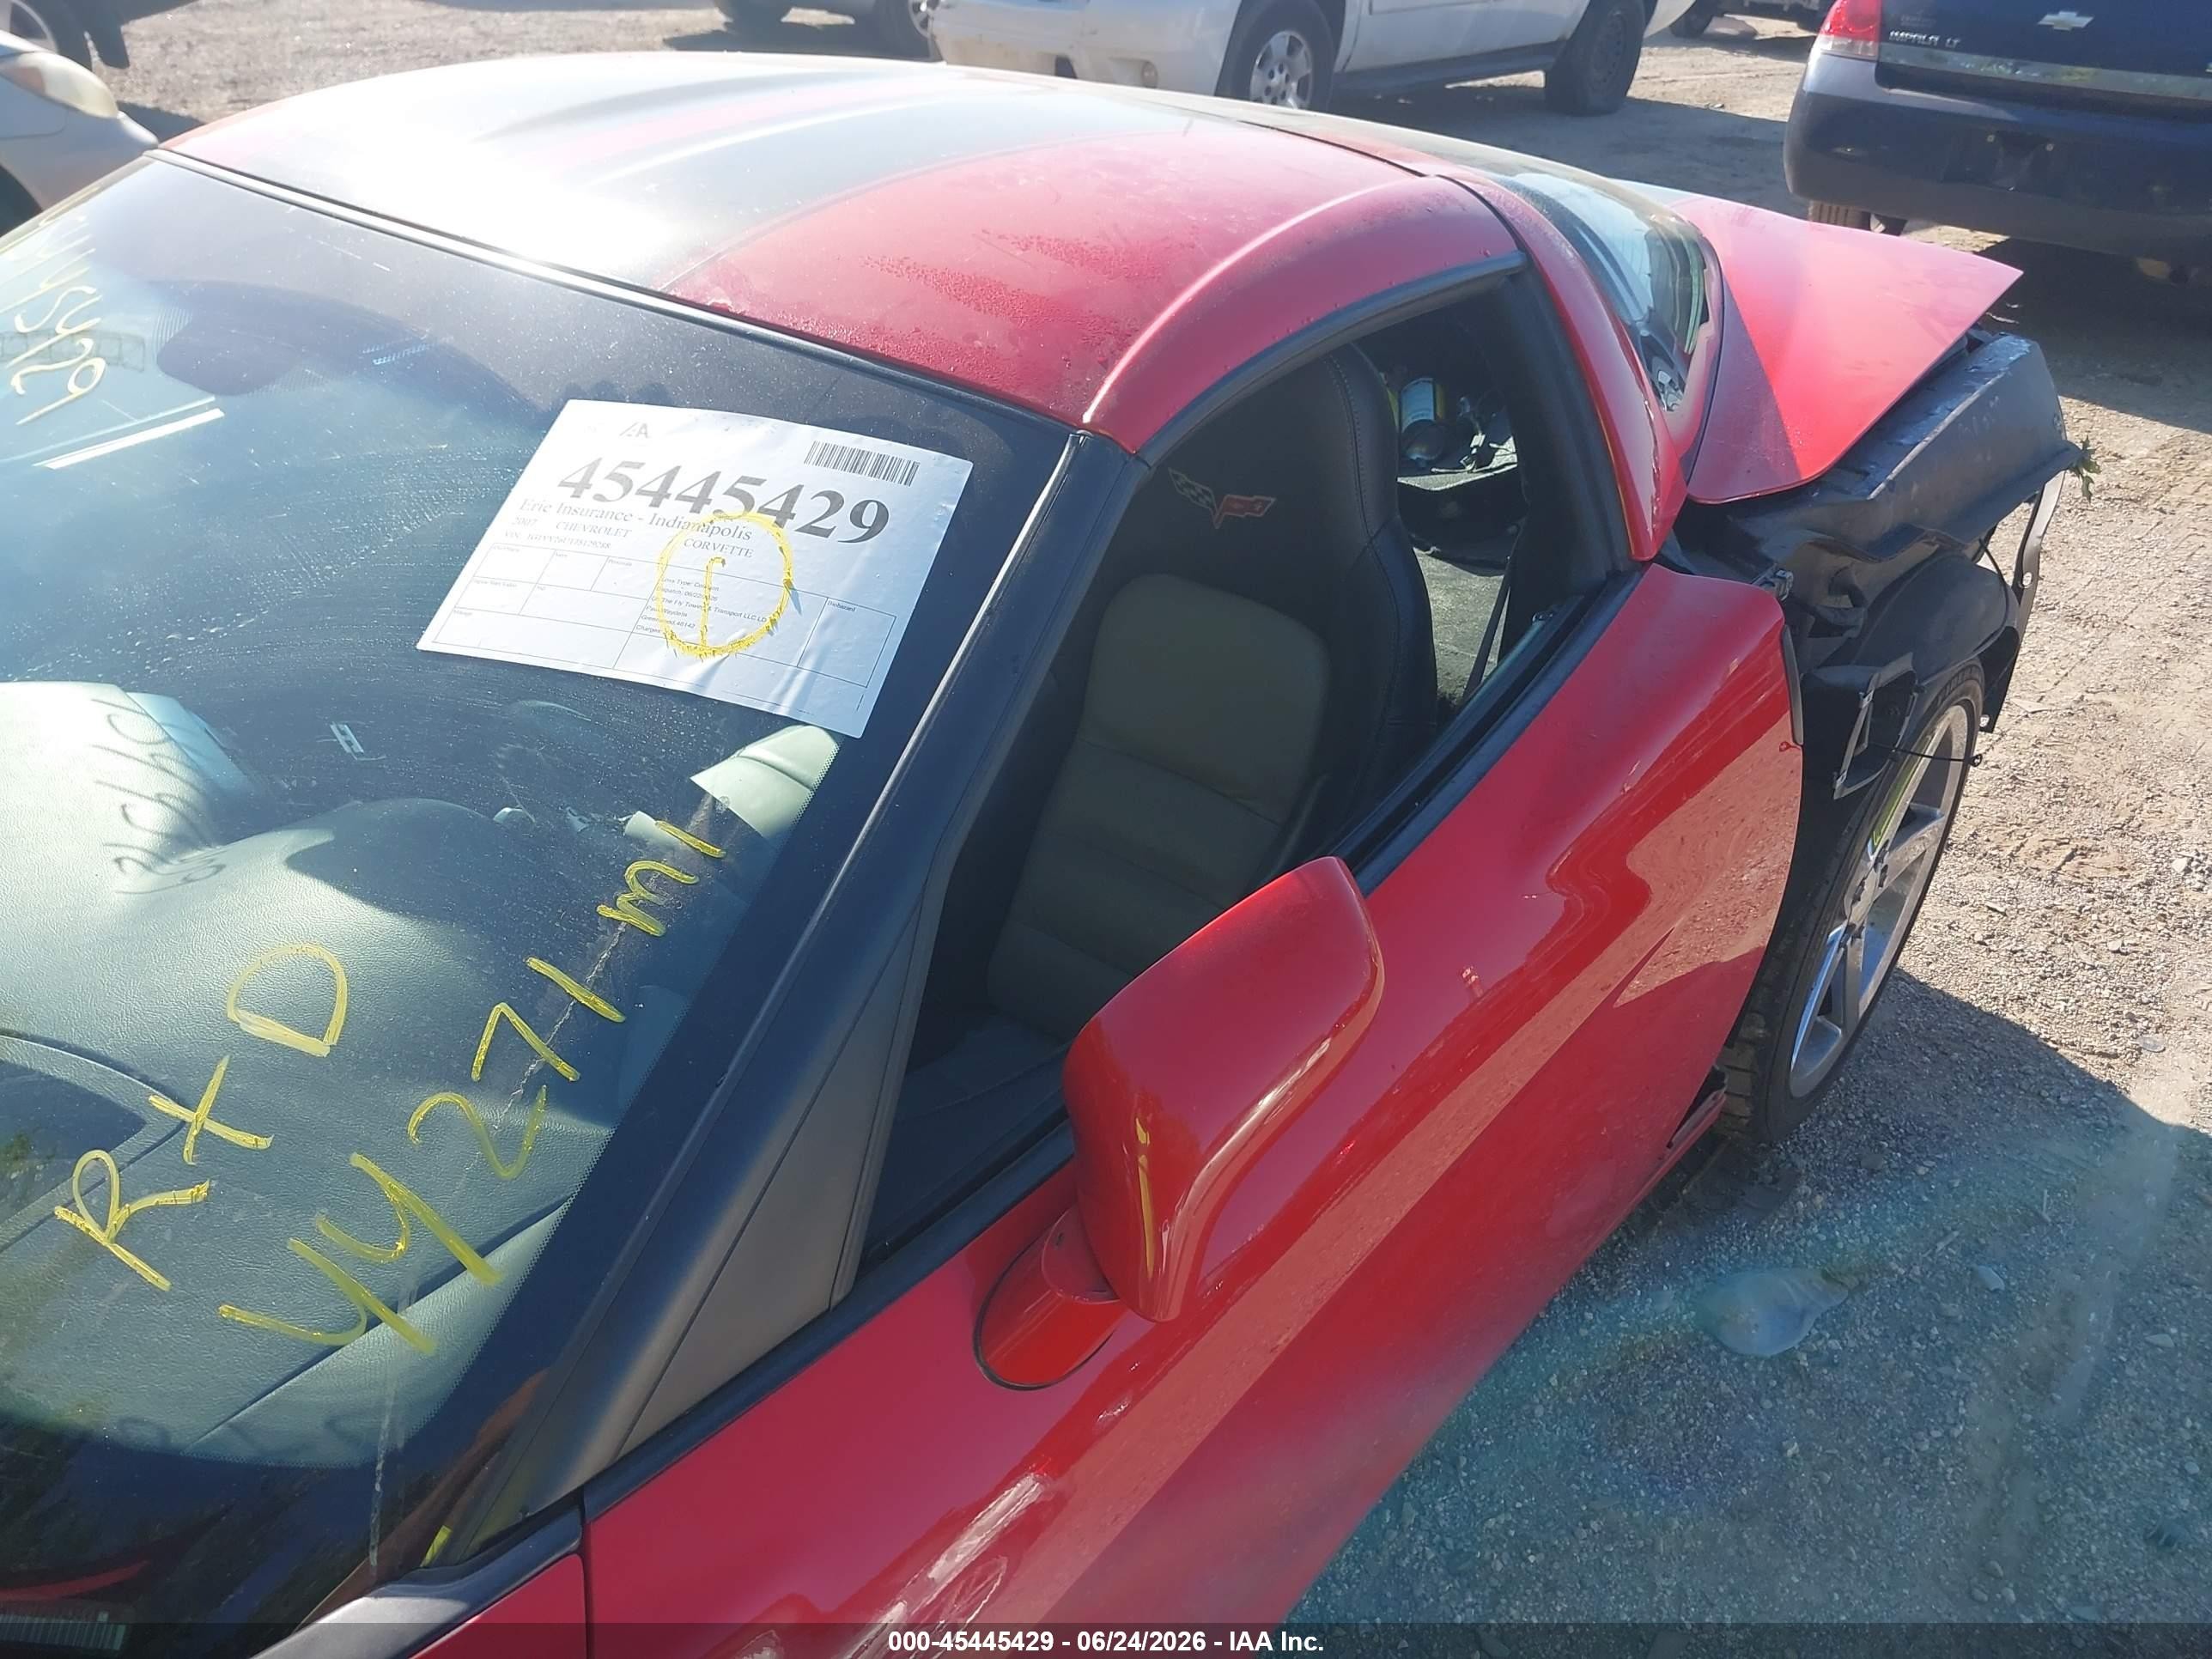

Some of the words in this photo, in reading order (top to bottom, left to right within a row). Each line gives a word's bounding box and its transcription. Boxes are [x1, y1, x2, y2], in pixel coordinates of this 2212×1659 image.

[558, 456, 890, 544] 45445429
[556, 501, 634, 522] Insurance
[649, 512, 753, 541] Indianapolis
[556, 520, 632, 538] CHEVROLET
[684, 538, 754, 558] CORVETTE
[714, 606, 744, 617] Transport
[744, 611, 757, 620] LLC
[827, 600, 856, 612] Biohazard
